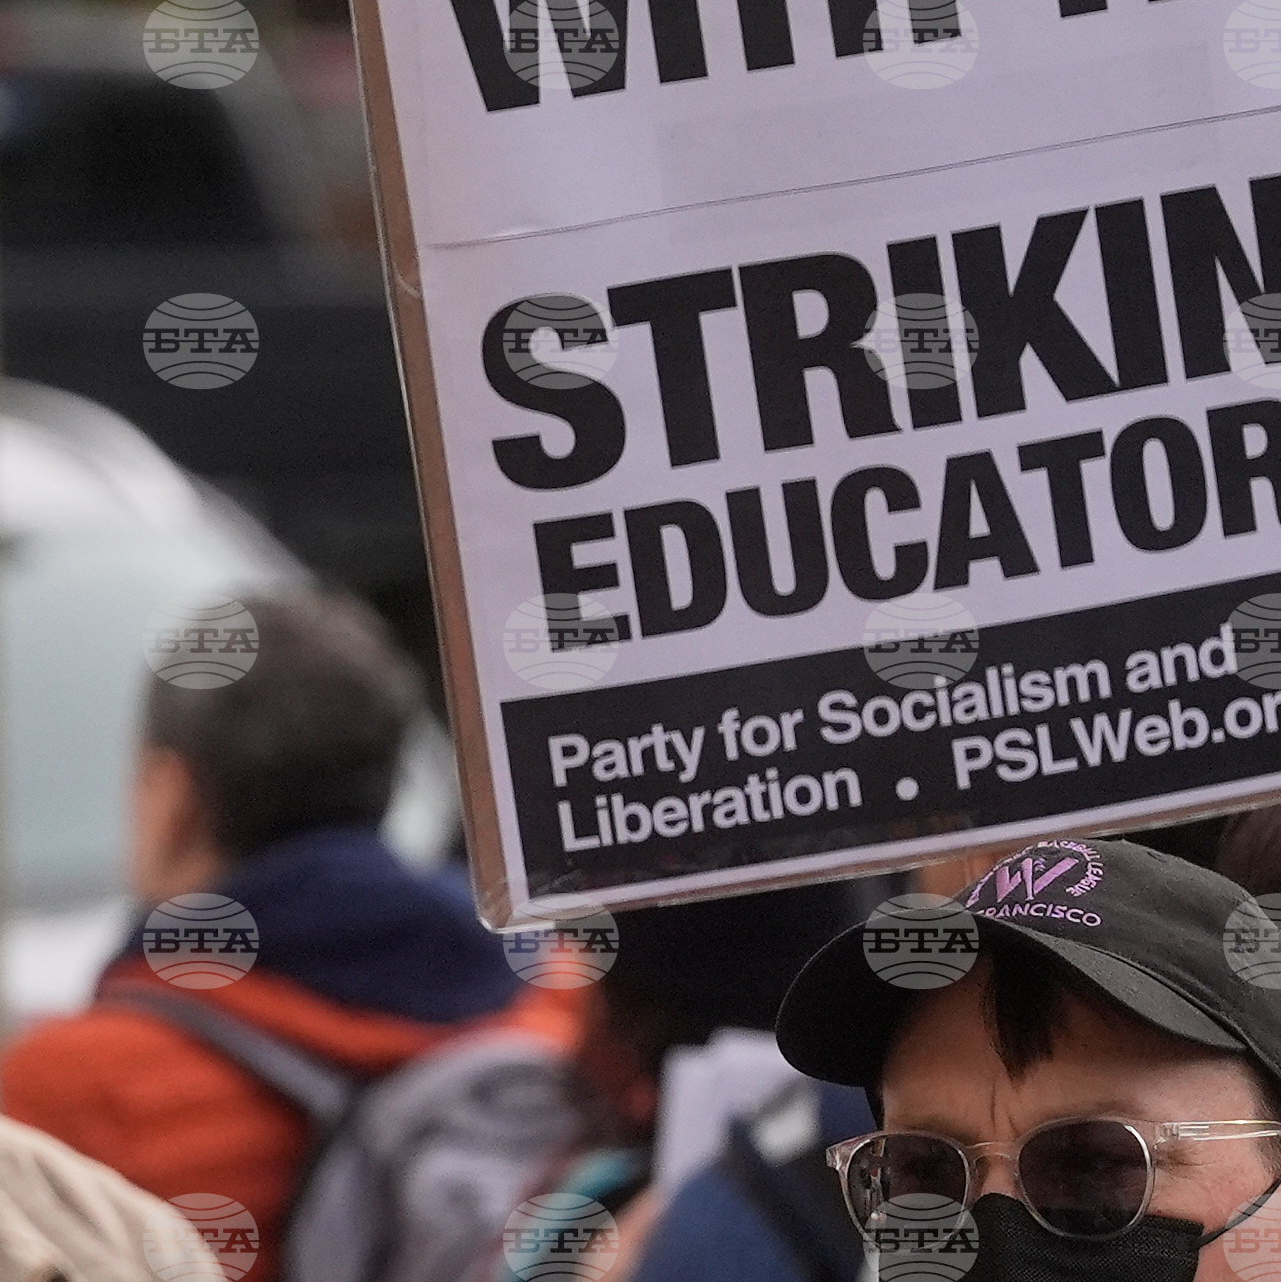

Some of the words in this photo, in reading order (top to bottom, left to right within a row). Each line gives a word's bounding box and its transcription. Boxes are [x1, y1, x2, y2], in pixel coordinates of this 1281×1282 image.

[547, 722, 705, 788] Party
[718, 706, 804, 761] for
[818, 659, 1111, 746] Socialism
[1125, 623, 1240, 693] and
[557, 766, 862, 853] Liberation
[977, 903, 1102, 927] RANCISCO
